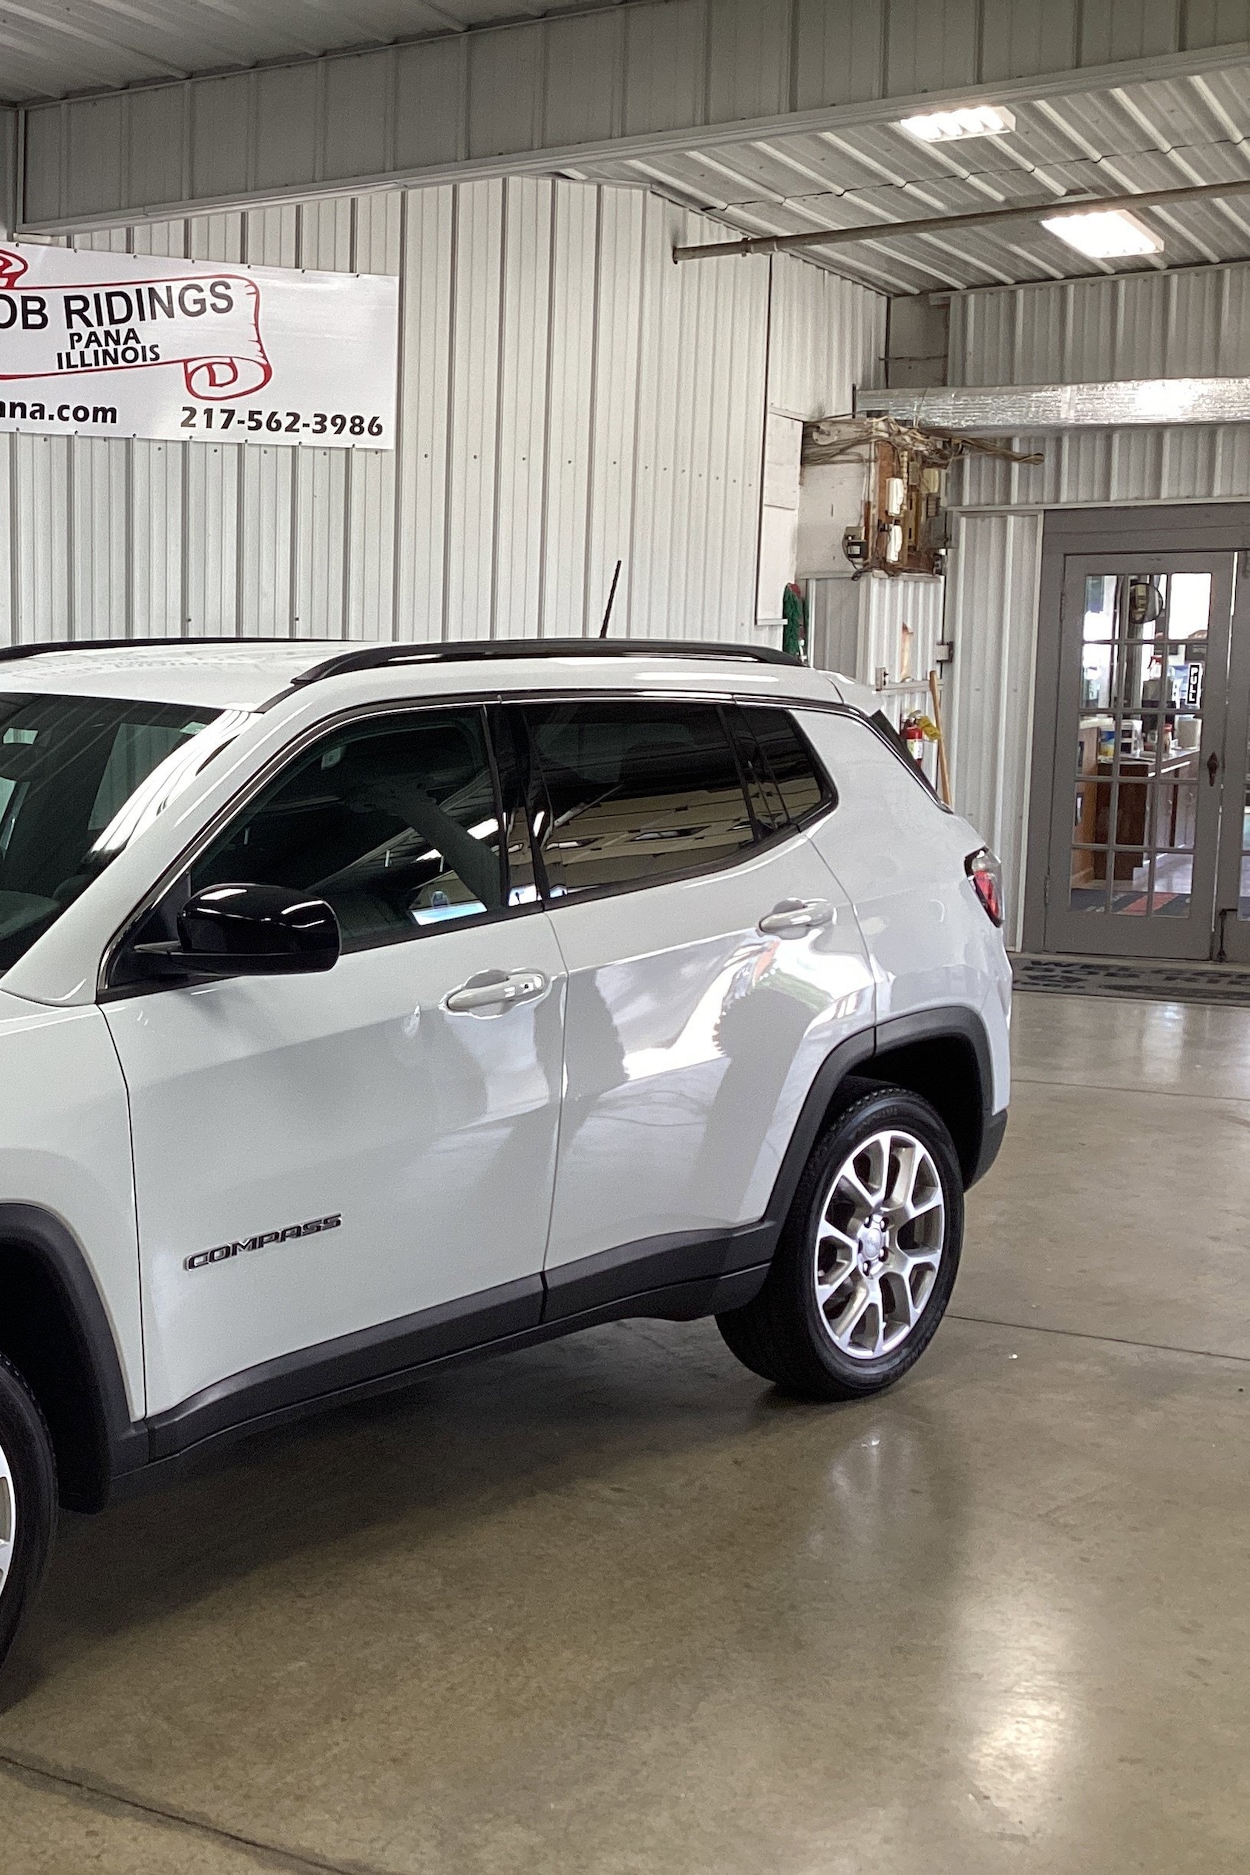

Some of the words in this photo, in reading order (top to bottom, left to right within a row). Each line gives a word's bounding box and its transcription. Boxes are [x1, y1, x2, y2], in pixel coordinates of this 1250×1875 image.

[64, 280, 234, 330] RIDINGS
[69, 328, 142, 350] PANA
[56, 344, 161, 370] ILLINOIS
[180, 406, 384, 437] 217-562-3986
[1188, 666, 1199, 702] PULL
[184, 1213, 343, 1271] COMPASS
